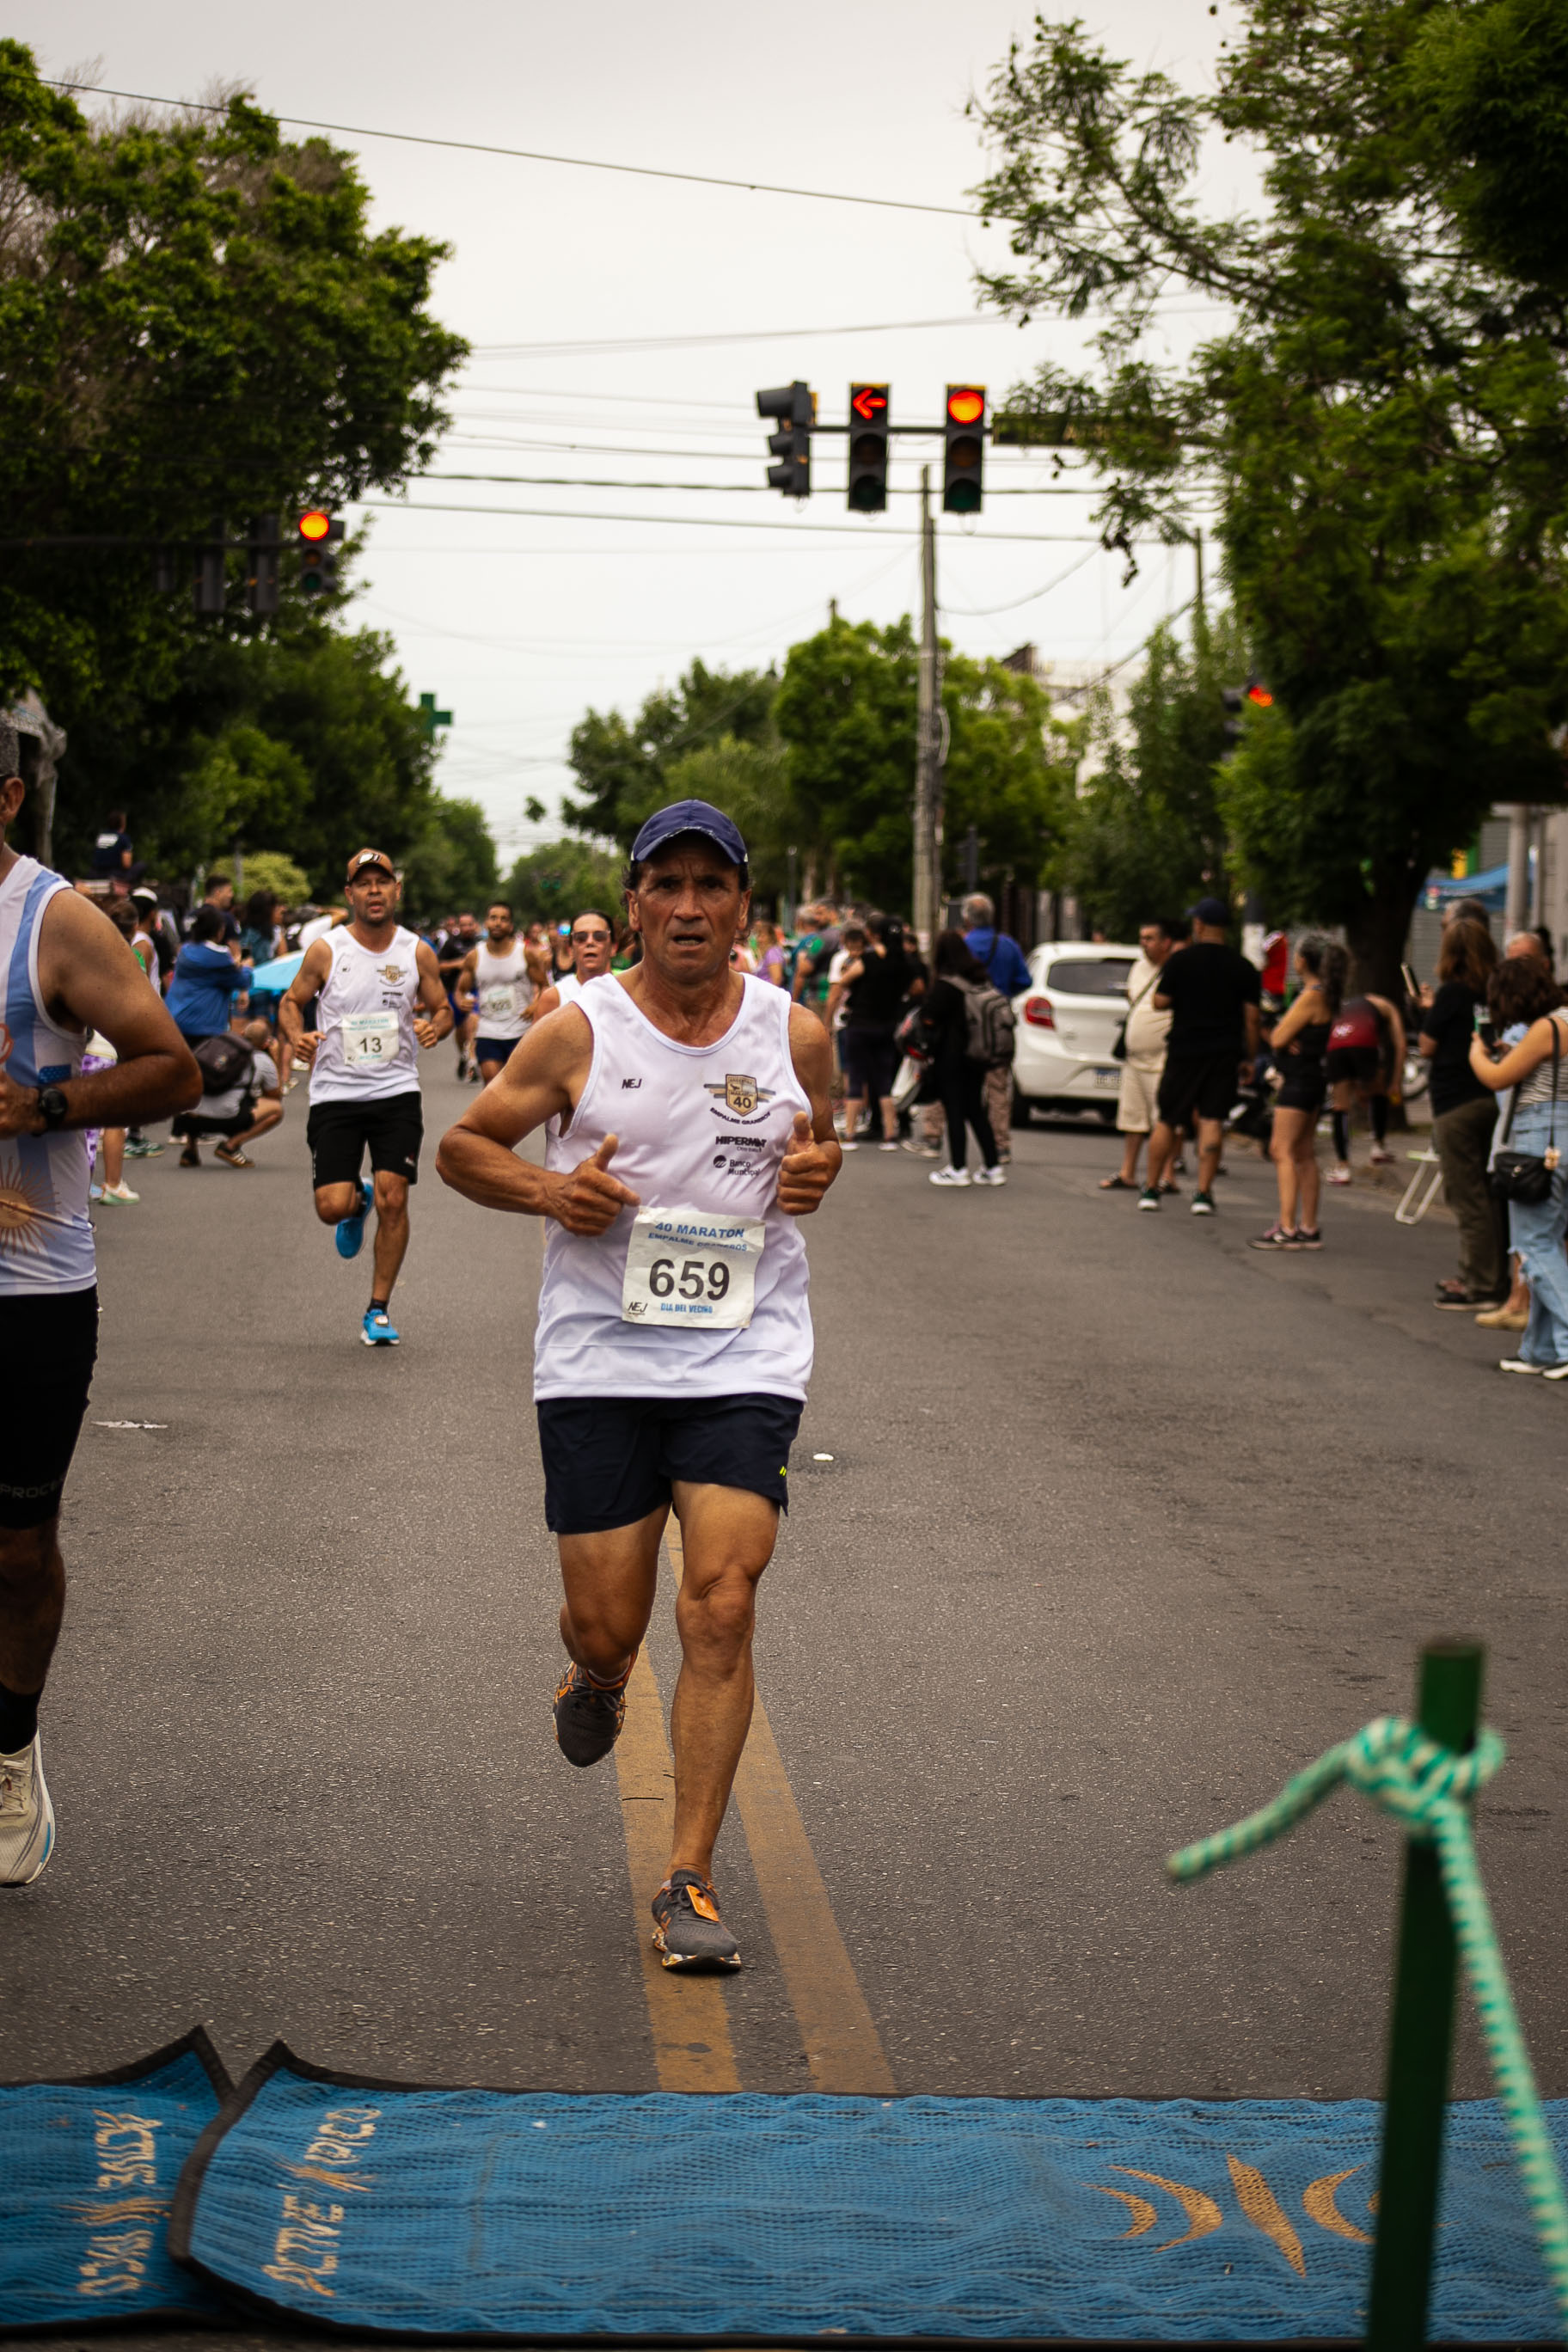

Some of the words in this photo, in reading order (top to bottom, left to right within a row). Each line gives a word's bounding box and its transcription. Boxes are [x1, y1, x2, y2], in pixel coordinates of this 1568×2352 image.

[359, 1037, 382, 1053] 13
[622, 1079, 642, 1089] NEJ
[733, 1096, 752, 1109] 40
[654, 1222, 673, 1233] 40
[677, 1224, 744, 1238] MARATON
[649, 1259, 730, 1301] 659
[660, 1302, 673, 1312] DIA
